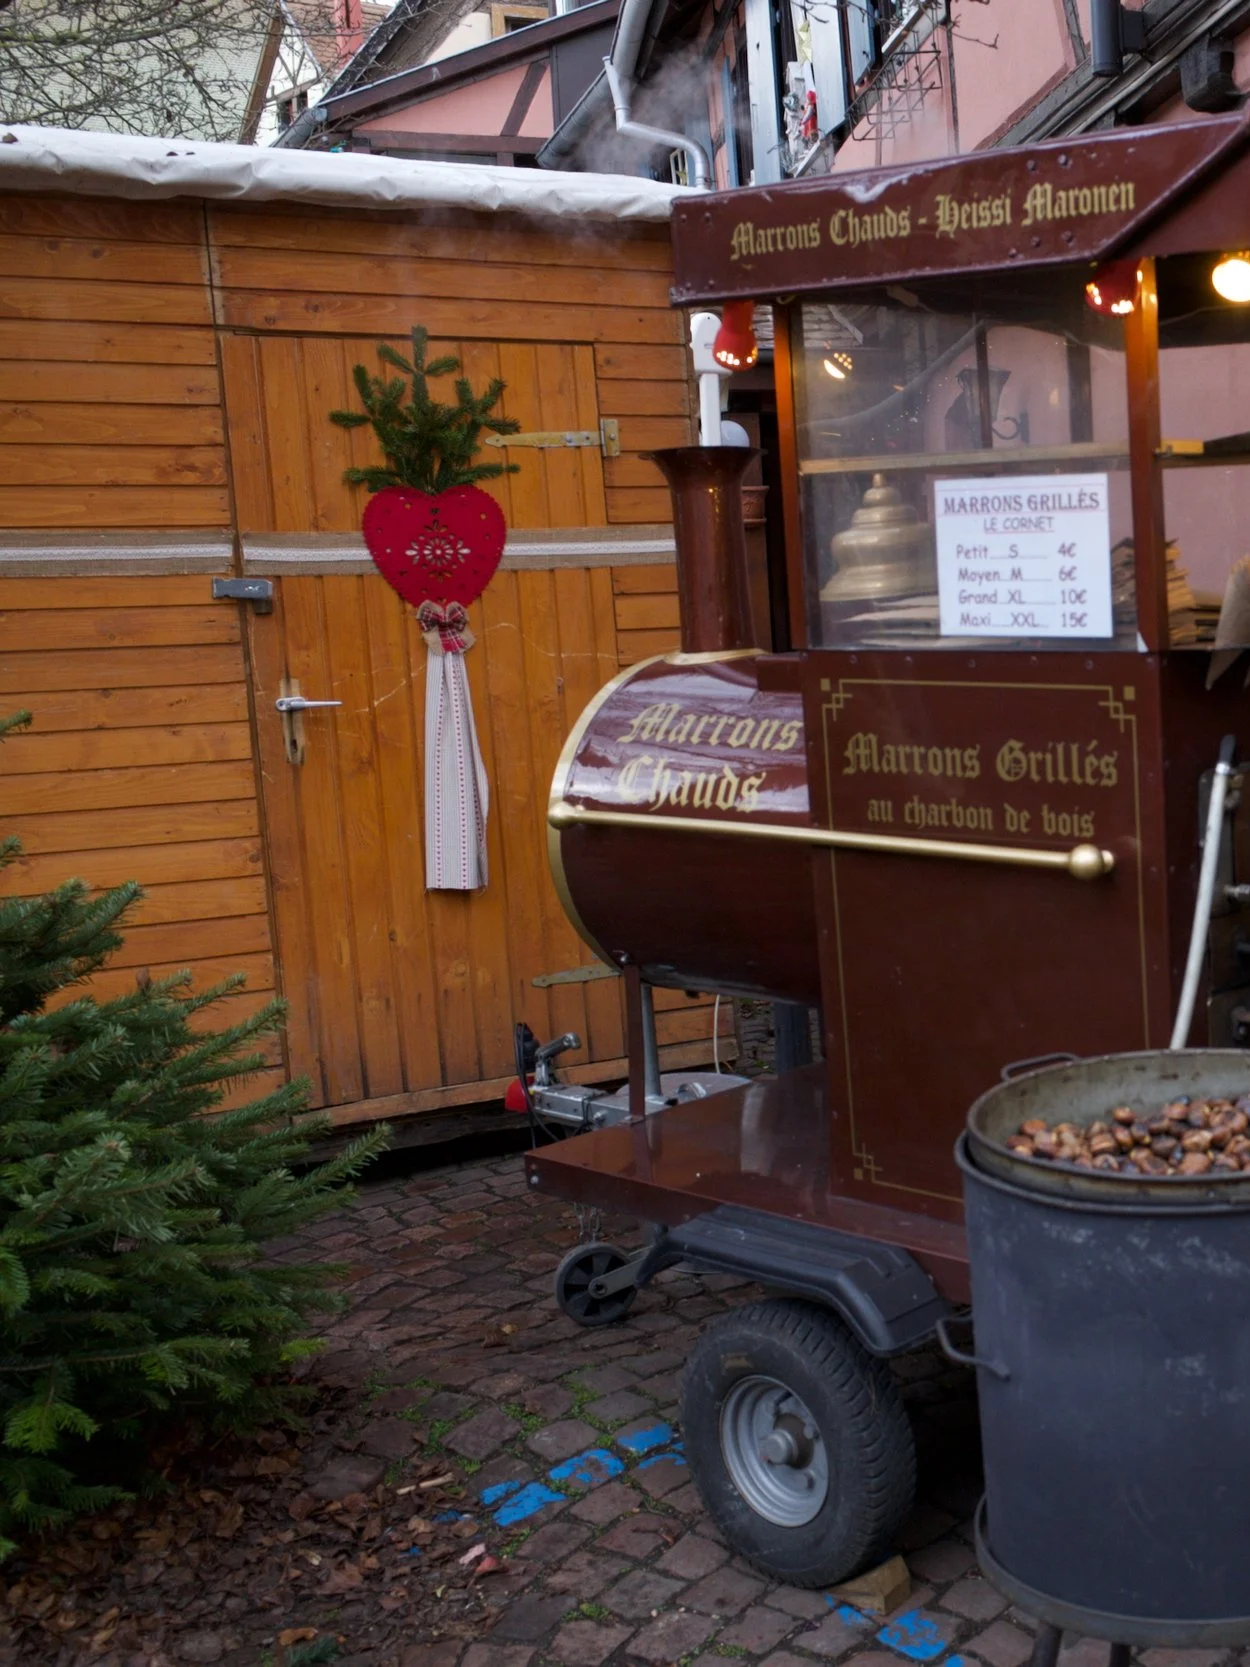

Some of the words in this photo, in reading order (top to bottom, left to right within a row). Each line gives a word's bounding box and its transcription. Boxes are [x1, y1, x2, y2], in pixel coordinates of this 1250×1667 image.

[730, 217, 821, 261] Marrons
[829, 204, 912, 249] Chauds
[935, 188, 1012, 239] Heissi
[1021, 181, 1135, 227] Maronen
[943, 496, 1023, 515] MARRONS
[1027, 489, 1100, 511] GRILLÉS
[983, 517, 998, 532] LE
[1003, 516, 1055, 531] CORNET
[956, 544, 989, 560] Petit
[1008, 544, 1019, 558] S
[1057, 542, 1077, 558] 4€
[958, 568, 1000, 586] Moyen
[1009, 567, 1024, 582] M
[1058, 566, 1077, 582] 6€
[958, 589, 998, 605] Grand
[1007, 589, 1026, 604] XL
[1060, 589, 1087, 605] 10€
[960, 613, 992, 627] Maxi
[1010, 612, 1040, 628] XXL
[1061, 612, 1088, 628] 15€
[616, 703, 804, 751] Marrons
[842, 737, 981, 779] Marrons
[996, 739, 1118, 787] Grillés
[617, 755, 767, 813] Chauds
[867, 799, 894, 823] au
[904, 796, 994, 830] charbon
[1004, 803, 1031, 834] de
[1041, 804, 1096, 838] bois
